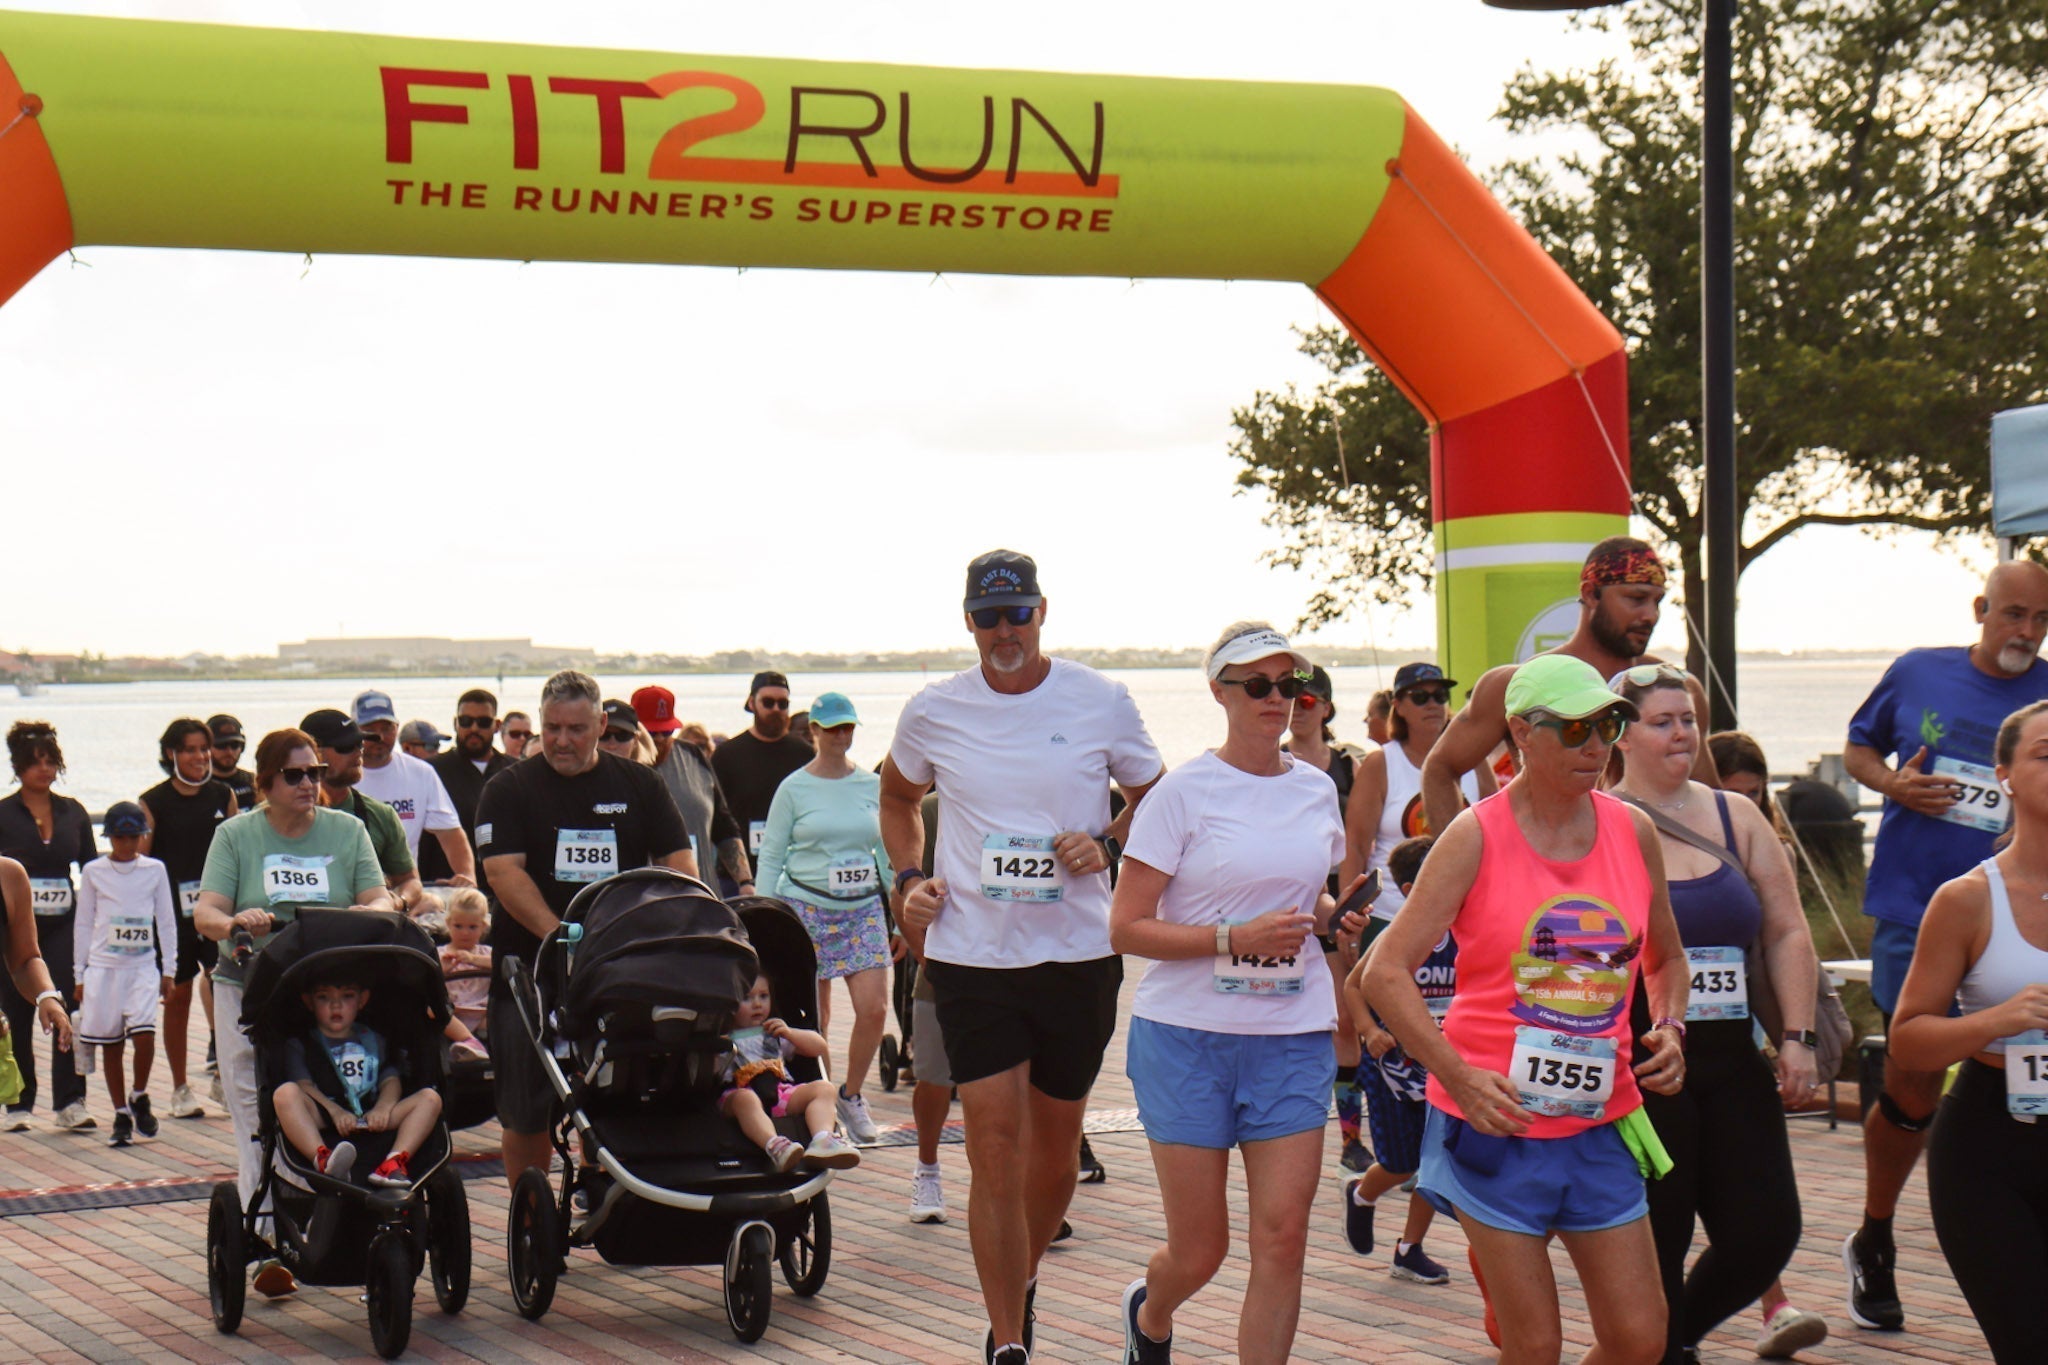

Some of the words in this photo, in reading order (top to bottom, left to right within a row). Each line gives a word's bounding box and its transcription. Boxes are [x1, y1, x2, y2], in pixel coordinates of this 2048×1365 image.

[380, 66, 1120, 198] FIT2RUN
[386, 180, 488, 209] THE
[513, 186, 775, 221] RUNNER'S
[796, 197, 1114, 233] SUPERSTORE
[1000, 568, 1022, 585] DADS
[1945, 782, 2001, 809] 379
[384, 799, 415, 812] ORE
[565, 847, 612, 864] 1388
[993, 856, 1054, 878] 1422
[271, 870, 319, 886] 1386
[836, 869, 870, 883] 1357
[33, 891, 67, 903] 1477
[114, 928, 149, 941] 1478
[1527, 1056, 1603, 1092] 1355
